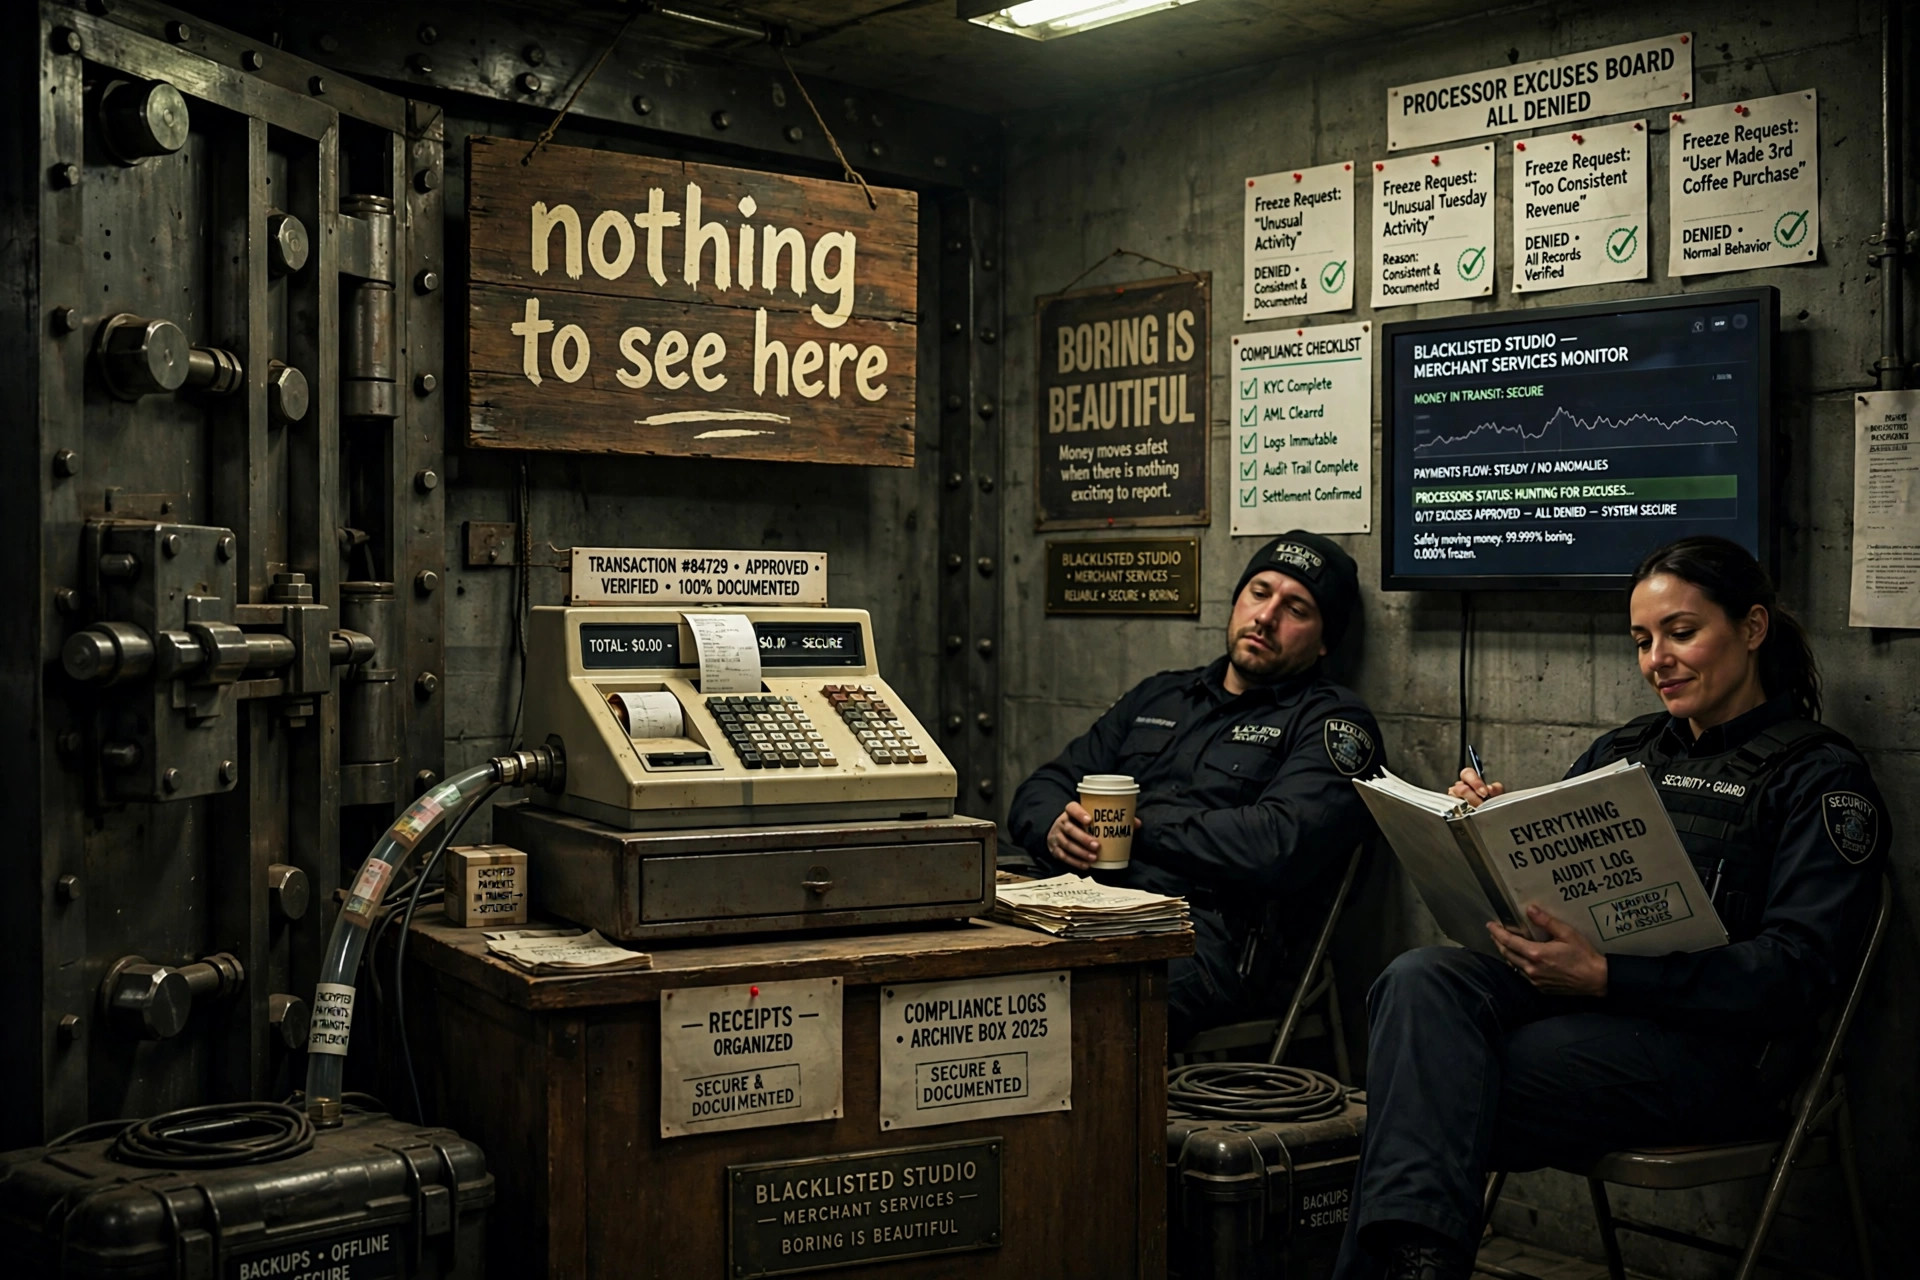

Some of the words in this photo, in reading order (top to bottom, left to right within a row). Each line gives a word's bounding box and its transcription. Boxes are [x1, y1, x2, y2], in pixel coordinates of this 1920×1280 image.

[1403, 78, 1507, 116] PROCESSOR
[1513, 61, 1598, 94] EXCUSES
[1605, 47, 1675, 81] BOARD
[1486, 104, 1518, 128] ALL
[1523, 90, 1591, 122] DENIED
[1683, 130, 1730, 150] Freeze
[1734, 118, 1799, 143] Request:
[1525, 158, 1568, 176] Freeze
[1572, 147, 1631, 171] Request:
[1726, 147, 1765, 166] Made
[1768, 139, 1793, 161] 3rd
[1383, 178, 1422, 196] Freeze
[1424, 170, 1477, 190] Request:
[1557, 168, 1628, 194] Consistent
[1682, 174, 1729, 195] Coffee
[1254, 195, 1291, 212] Freeze
[1293, 187, 1342, 207] Request:
[1438, 188, 1487, 209] Tuesday
[1525, 232, 1570, 251] DENIED
[1682, 224, 1732, 244] DENIED
[531, 181, 856, 328] nothing
[1382, 253, 1419, 266] Reason:
[1525, 251, 1539, 266] All
[1541, 247, 1582, 264] Records
[1682, 242, 1721, 261] Normal
[1725, 238, 1772, 256] Behavior
[1254, 264, 1291, 280] DENIED
[1382, 264, 1431, 281] Consistent
[1524, 264, 1564, 281] Verified
[1382, 278, 1440, 296] Documented
[511, 297, 590, 387] to
[615, 326, 727, 392] see
[753, 307, 888, 401] here
[1058, 314, 1160, 374] BORING
[1167, 309, 1196, 364] IS
[1240, 342, 1303, 362] COMPLIANCE
[1305, 336, 1362, 356] CHECKLIST
[1413, 337, 1501, 360] BLACKLISTED
[1504, 332, 1557, 351] STUDIO
[1413, 358, 1488, 379] MERCHANT
[1491, 352, 1557, 373] SERVICES
[1560, 346, 1629, 367] MONITOR
[1263, 379, 1284, 394] KYC
[1287, 377, 1333, 395] Complete
[1413, 391, 1448, 405] MONEY
[1449, 390, 1461, 402] IN
[1462, 388, 1505, 401] TRANSIT:
[1506, 384, 1544, 399] SECURE
[1048, 373, 1196, 434] BEAUTIFUL
[1263, 407, 1286, 421] AML
[1059, 444, 1095, 463] Money
[1097, 444, 1133, 458] moves
[1134, 437, 1169, 455] safest
[1263, 435, 1286, 452] Logs
[1289, 431, 1338, 447] Immutable
[1061, 463, 1090, 481] when
[1092, 462, 1122, 479] there
[1124, 461, 1134, 478] is
[1136, 459, 1179, 479] nothing
[1263, 461, 1288, 476] Audit
[1291, 460, 1312, 475] Trail
[1314, 458, 1359, 477] Complete
[1413, 466, 1461, 479] PAYMENTS
[1462, 464, 1493, 478] FLOW:
[1493, 462, 1529, 476] STEADY
[1537, 461, 1552, 474] NO
[1553, 459, 1609, 473] ANOMALIES
[1071, 484, 1114, 504] exciting
[1116, 484, 1129, 499] to
[1131, 482, 1172, 503] report.
[1314, 485, 1362, 501] Confirmed
[1415, 490, 1475, 504] PROCESSORS
[1475, 488, 1513, 501] STATUS:
[1514, 486, 1558, 500] HUNTING
[1560, 486, 1580, 498] FOR
[1435, 508, 1473, 521] EXCUSES
[1474, 507, 1521, 520] APPROVED
[1534, 507, 1552, 519] ALL
[1553, 505, 1587, 518] DENIED
[1601, 504, 1638, 517] SYSTEM
[1640, 503, 1678, 516] SECURE
[1440, 532, 1472, 548] moving
[1505, 530, 1543, 543] 99.999%
[1544, 530, 1576, 545] boring.
[588, 556, 677, 574] TRANSACTION
[681, 558, 729, 575] #84729
[745, 559, 809, 576] APPROVED
[1061, 552, 1134, 567] BLACKLISTED
[1137, 551, 1182, 566] STUDIO
[601, 578, 659, 595] VERIFIED
[678, 578, 713, 596] 100%
[717, 578, 800, 596] DOCUMENTED
[1073, 570, 1124, 583] MERCHANT
[1125, 569, 1168, 583] SERVICES
[1107, 589, 1140, 602] SECURE
[588, 638, 629, 654] TOTAL:
[630, 637, 663, 653] $0.00
[801, 636, 844, 649] SECURE
[1661, 774, 1706, 790] SECURITY
[1712, 780, 1746, 797] GUARD
[1093, 808, 1127, 823] DECAF
[1828, 795, 1873, 817] SECURITY
[1103, 824, 1131, 839] DRAMA
[1509, 800, 1621, 846] EVERYTHING
[1508, 850, 1529, 870] IS
[1529, 817, 1647, 865] DOCUMENTED
[1551, 858, 1597, 886] AUDIT
[1600, 849, 1636, 871] LOG
[1559, 867, 1643, 902] 2024-2025
[1615, 922, 1633, 934] NO
[1634, 910, 1673, 929] ISSUES
[708, 1005, 793, 1034] RECEIPTS
[904, 996, 1003, 1025] COMPLIANCE
[1006, 992, 1047, 1015] LOGS
[910, 1023, 974, 1049] ARCHIVE
[978, 1021, 1007, 1043] BOX
[1011, 1017, 1049, 1039] 2025
[713, 1032, 794, 1057] ORGANIZED
[930, 1062, 987, 1083] SECURE
[991, 1059, 1002, 1076] &
[695, 1076, 749, 1098] SECURE
[753, 1073, 764, 1091] &
[923, 1077, 1022, 1104] DOCUMENTED
[755, 1169, 895, 1205] BLACKLISTED
[902, 1160, 977, 1188] STUDIO
[783, 1201, 872, 1226] MERCHANT
[879, 1190, 955, 1214] SERVICES
[1303, 1188, 1349, 1210] BACKUPS
[1310, 1207, 1348, 1228] SECURE
[782, 1232, 844, 1255] BORING
[851, 1229, 866, 1247] IS
[873, 1218, 959, 1244] BEAUTIFUL
[240, 1250, 311, 1280] BACKUPS
[331, 1234, 390, 1262] OFFLINE
